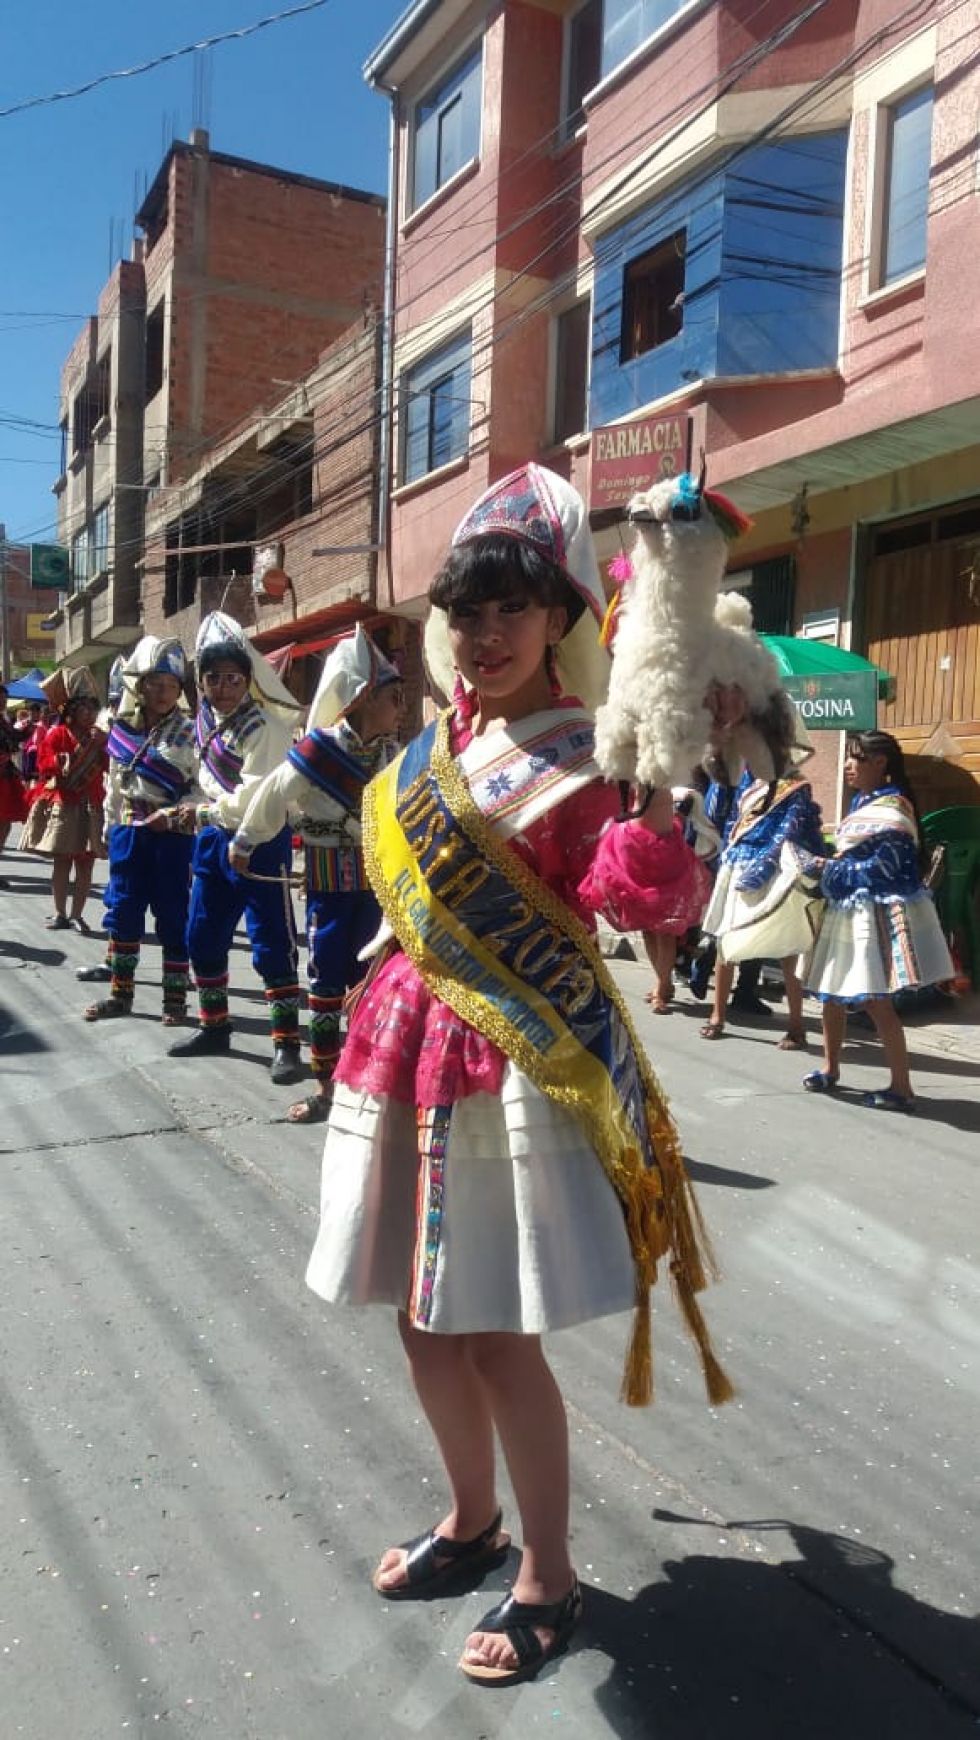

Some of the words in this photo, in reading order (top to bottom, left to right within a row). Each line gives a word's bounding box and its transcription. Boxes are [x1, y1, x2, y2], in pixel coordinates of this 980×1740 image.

[596, 418, 682, 461] FARMACIA
[792, 698, 855, 718] TOSINA
[398, 769, 491, 910] USTA
